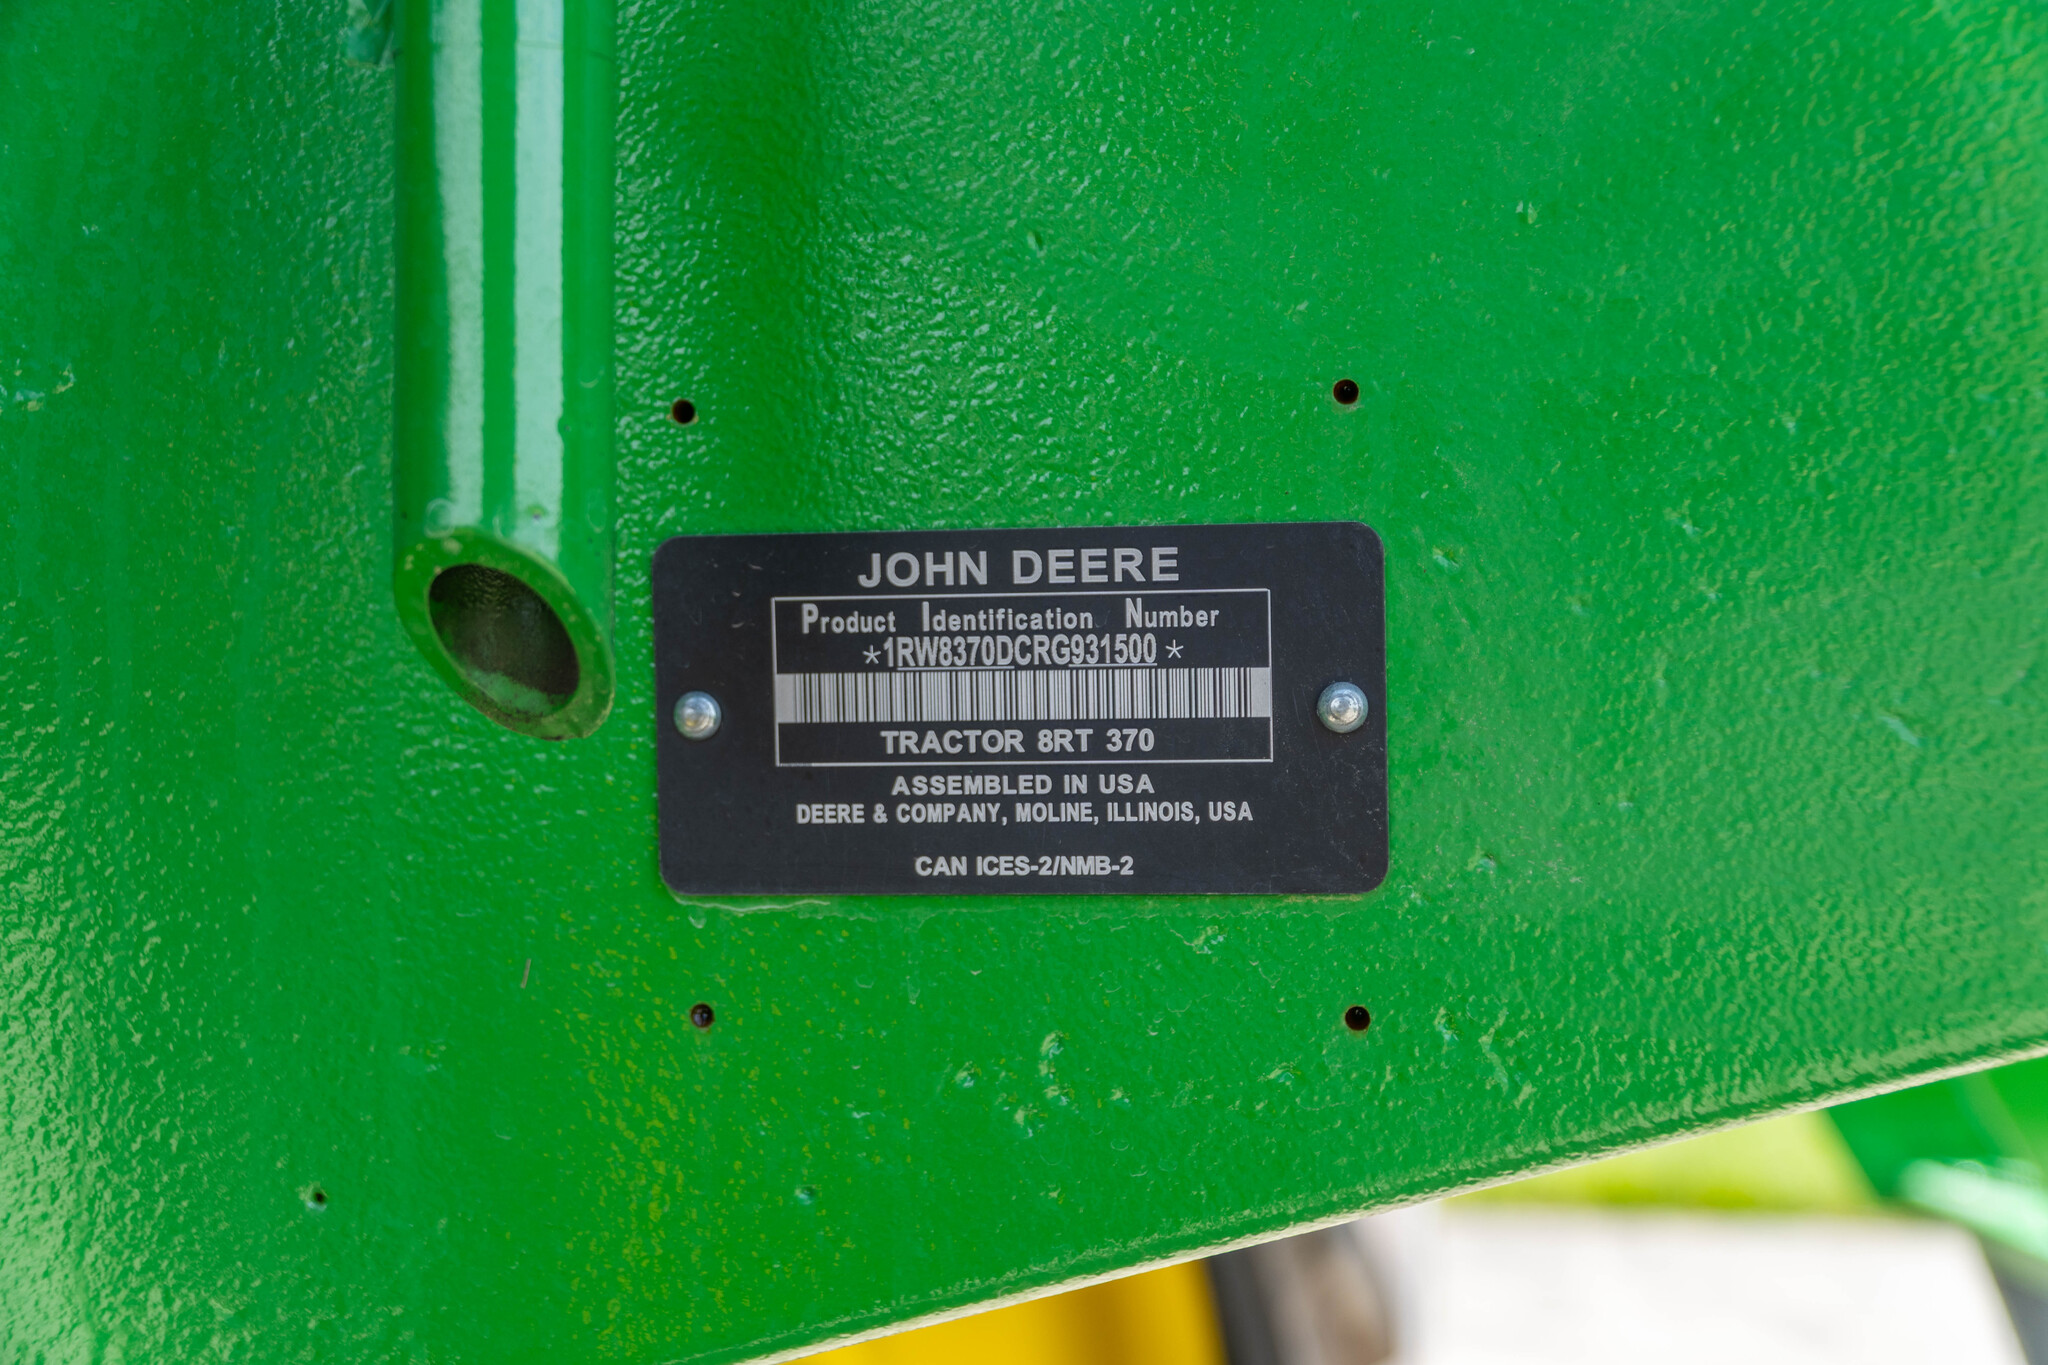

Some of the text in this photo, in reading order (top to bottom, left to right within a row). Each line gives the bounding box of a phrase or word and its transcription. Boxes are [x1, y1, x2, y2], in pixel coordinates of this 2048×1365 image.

[858, 546, 1180, 588] JOHN DEERE
[802, 597, 1220, 634] Product Identification Number
[880, 727, 1155, 755] TRACTOR 8RT 370
[891, 773, 1155, 796] ASSEMBLED IN USA
[796, 800, 1254, 826] DEERE & COMPANY, MOLINE, ILLINOIS, USA
[914, 855, 1134, 877] CAN ICES-2/NMB-2
